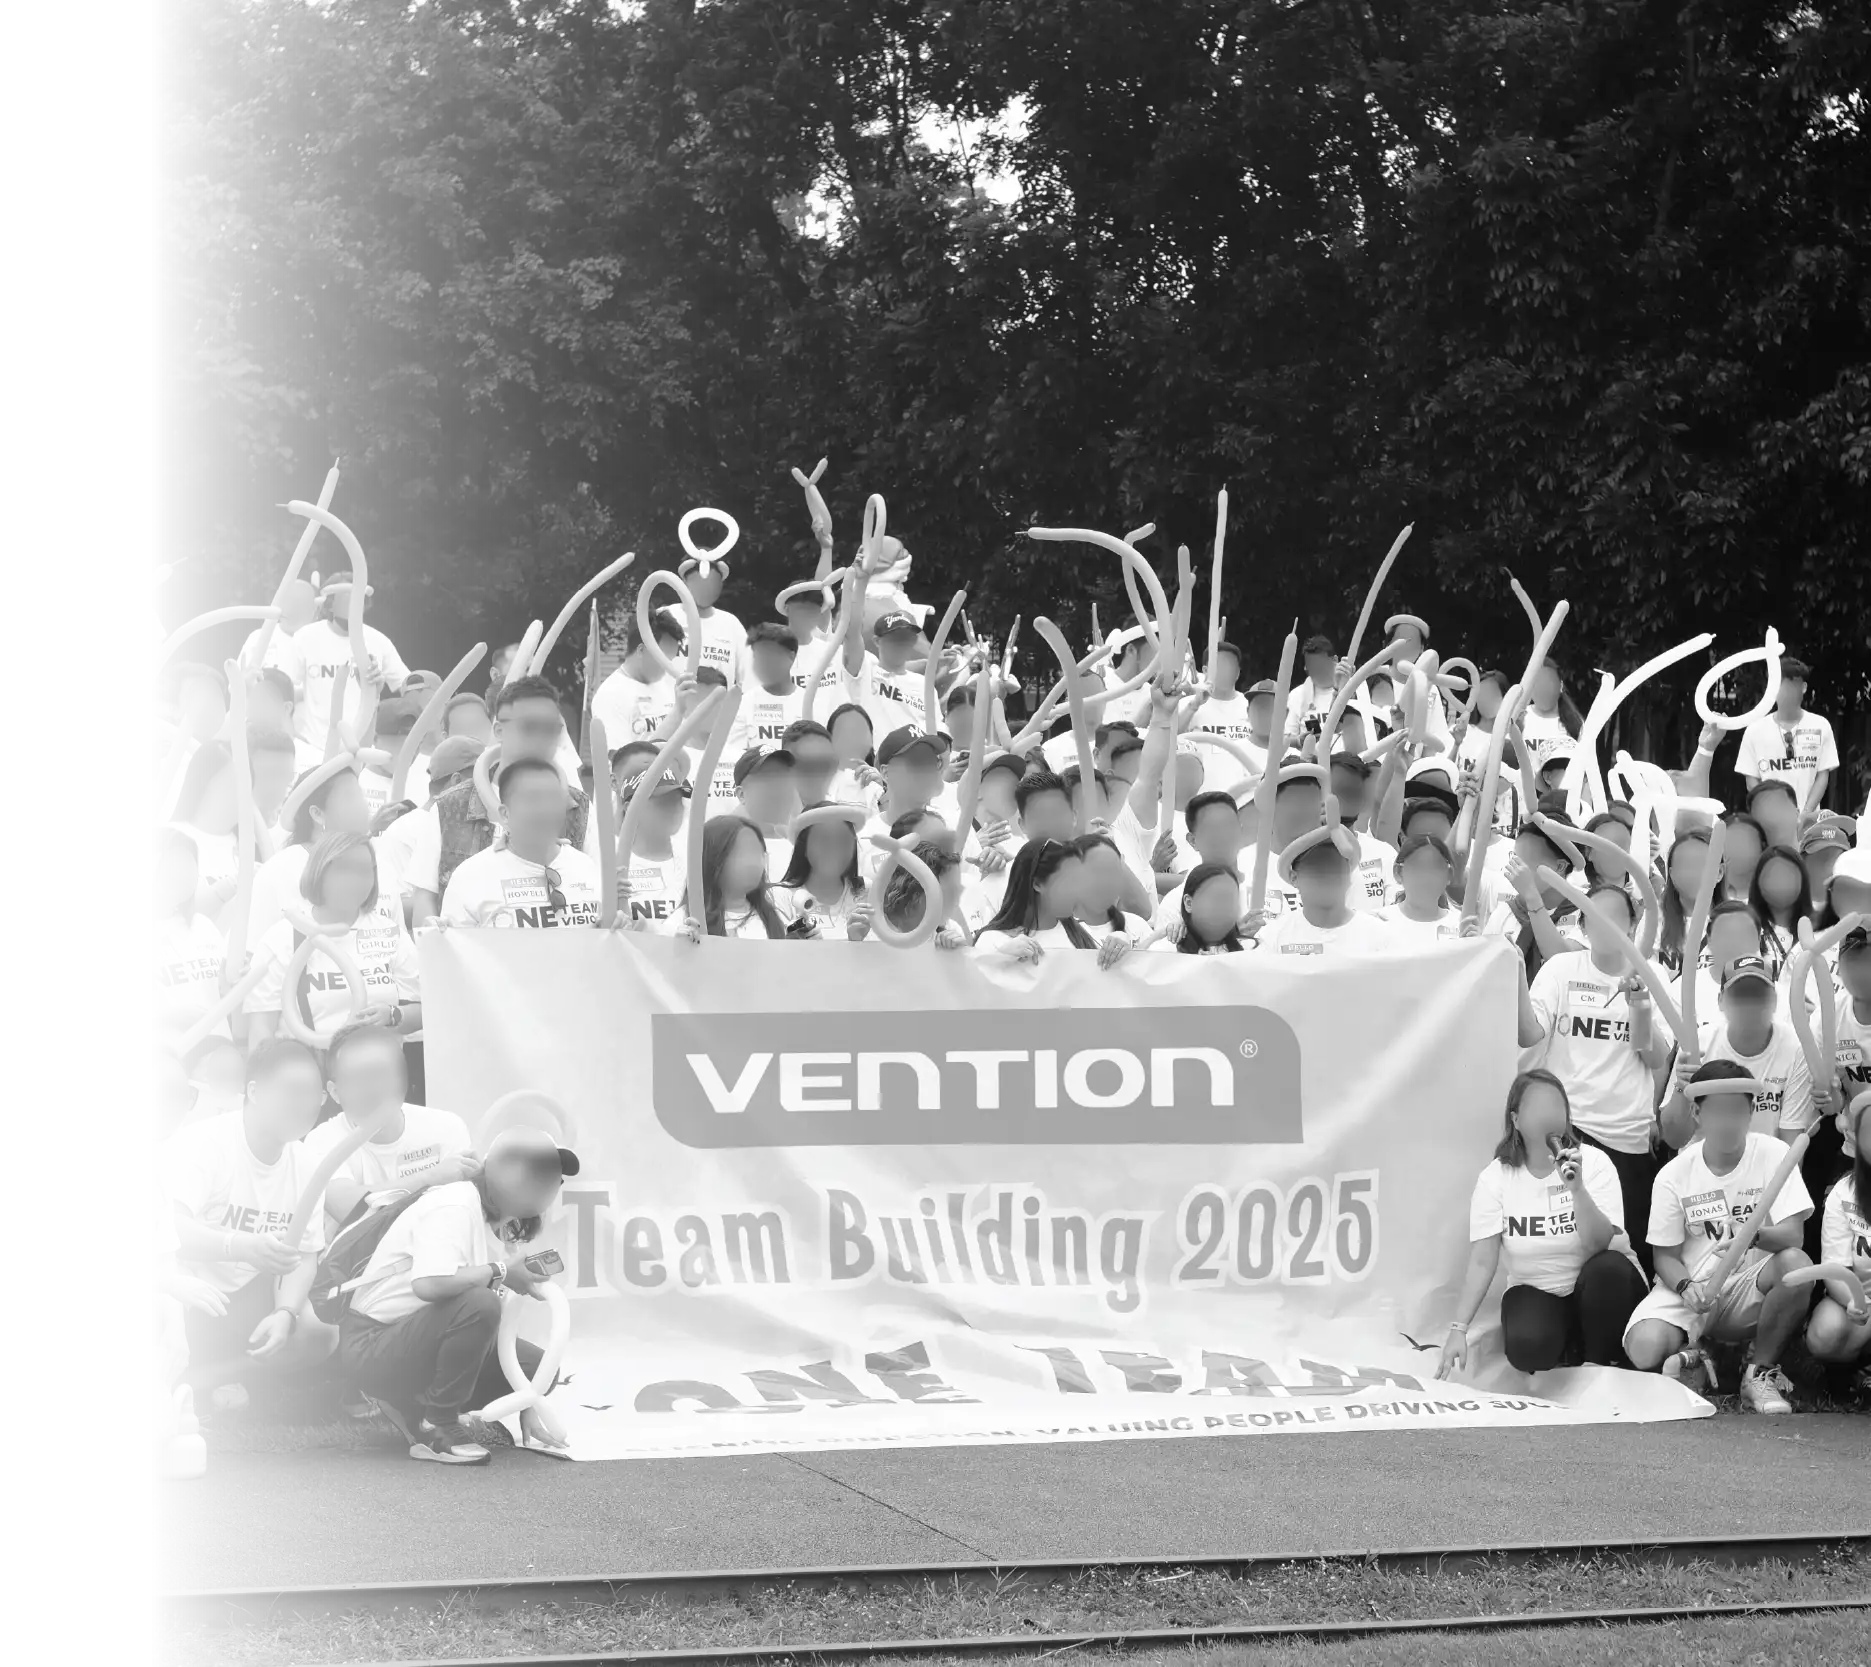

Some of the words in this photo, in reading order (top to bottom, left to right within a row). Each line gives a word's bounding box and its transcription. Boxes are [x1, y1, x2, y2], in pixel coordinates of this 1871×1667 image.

[703, 646, 730, 657] TEAM
[508, 889, 545, 899] HOWELL
[630, 900, 668, 921] NE
[561, 915, 598, 927] VISIO
[152, 963, 189, 991] NE
[306, 972, 347, 991] NE
[1576, 982, 1601, 992] HELLO
[1580, 994, 1596, 1002] CM
[686, 1047, 1235, 1114] VENTION
[1845, 1066, 1871, 1084] NE
[404, 1148, 432, 1161] HELLO
[1690, 1192, 1717, 1203] HELLO
[220, 1204, 260, 1229] NE
[1690, 1203, 1724, 1218] JONAS
[1508, 1215, 1546, 1237] NE
[1547, 1210, 1576, 1226] TEA
[561, 1190, 791, 1288] Team
[826, 1188, 1144, 1314] Building
[1178, 1178, 1373, 1282] 2025
[1203, 1406, 1336, 1429] PEOPLE
[1344, 1399, 1481, 1420] DRIVING
